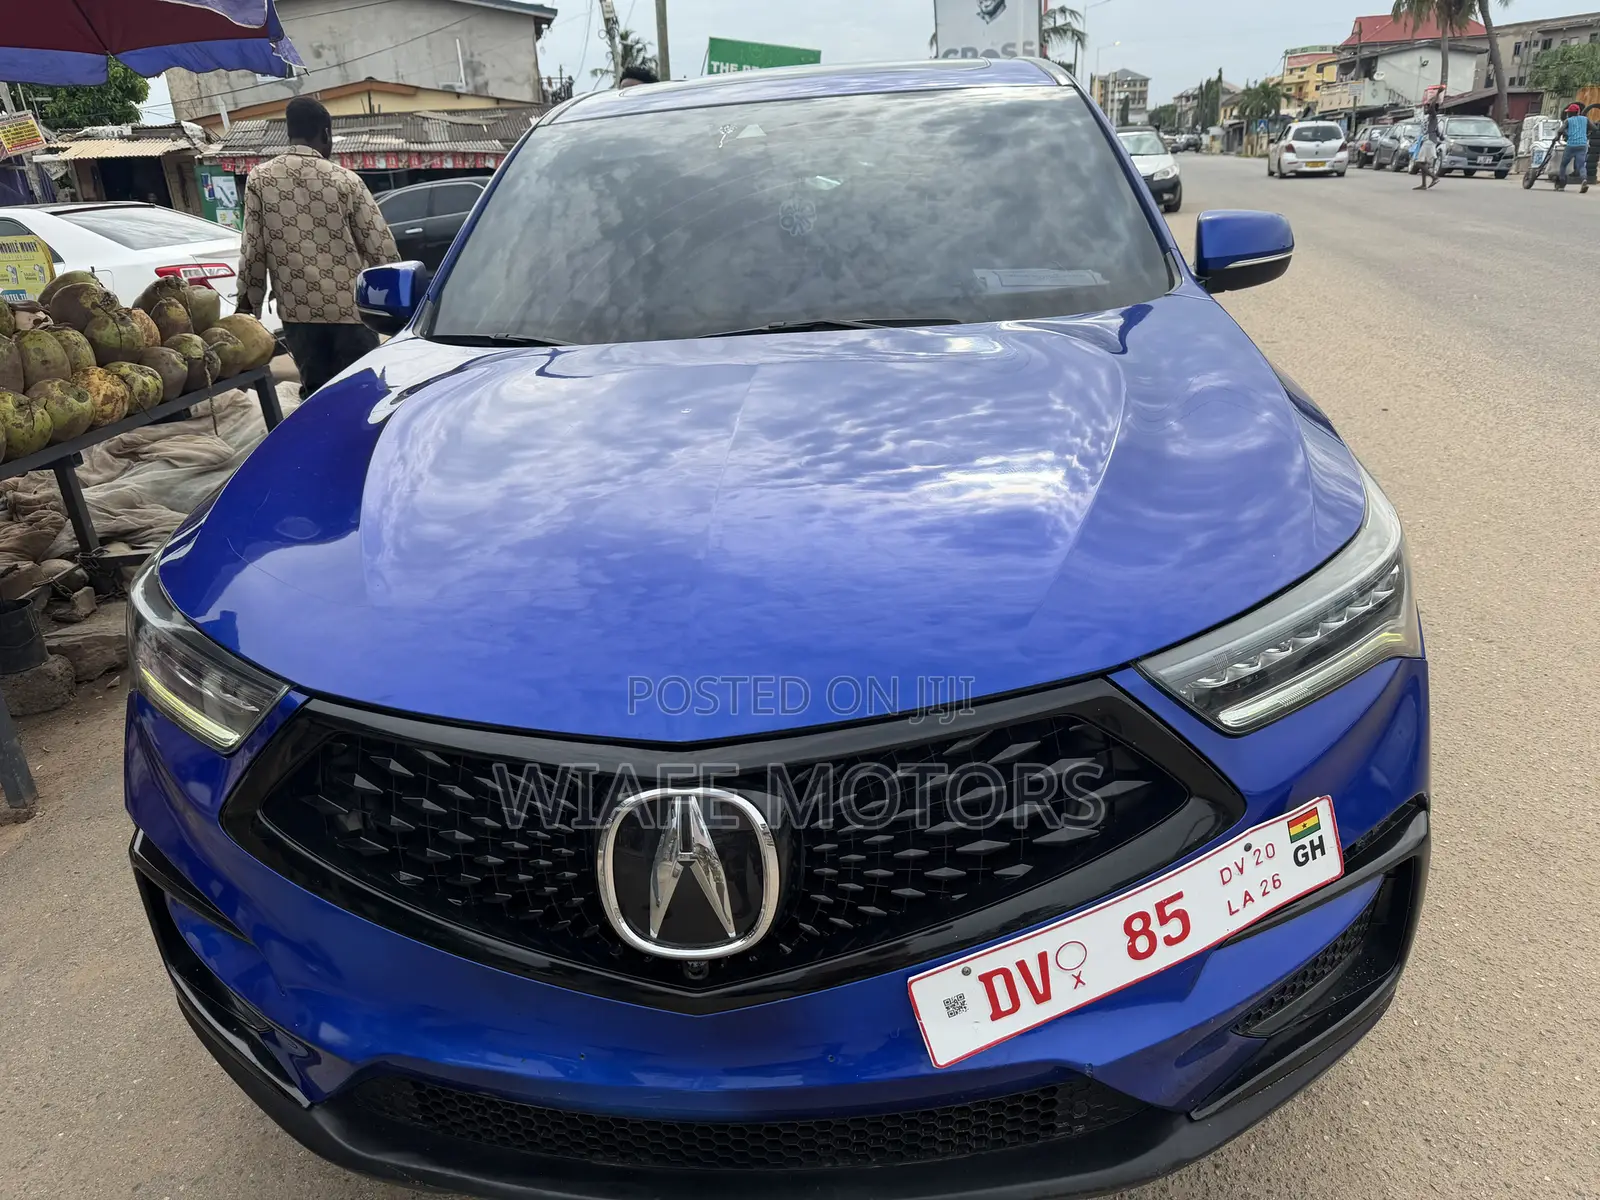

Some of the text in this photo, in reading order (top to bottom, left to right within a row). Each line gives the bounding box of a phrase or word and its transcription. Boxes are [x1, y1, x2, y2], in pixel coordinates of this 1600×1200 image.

[711, 61, 738, 73] THE
[18, 241, 38, 252] MONEY
[1219, 841, 1276, 886] DV 20
[1292, 834, 1327, 868] GH
[1226, 872, 1283, 917] LA 26
[977, 890, 1192, 1022] DV 85
